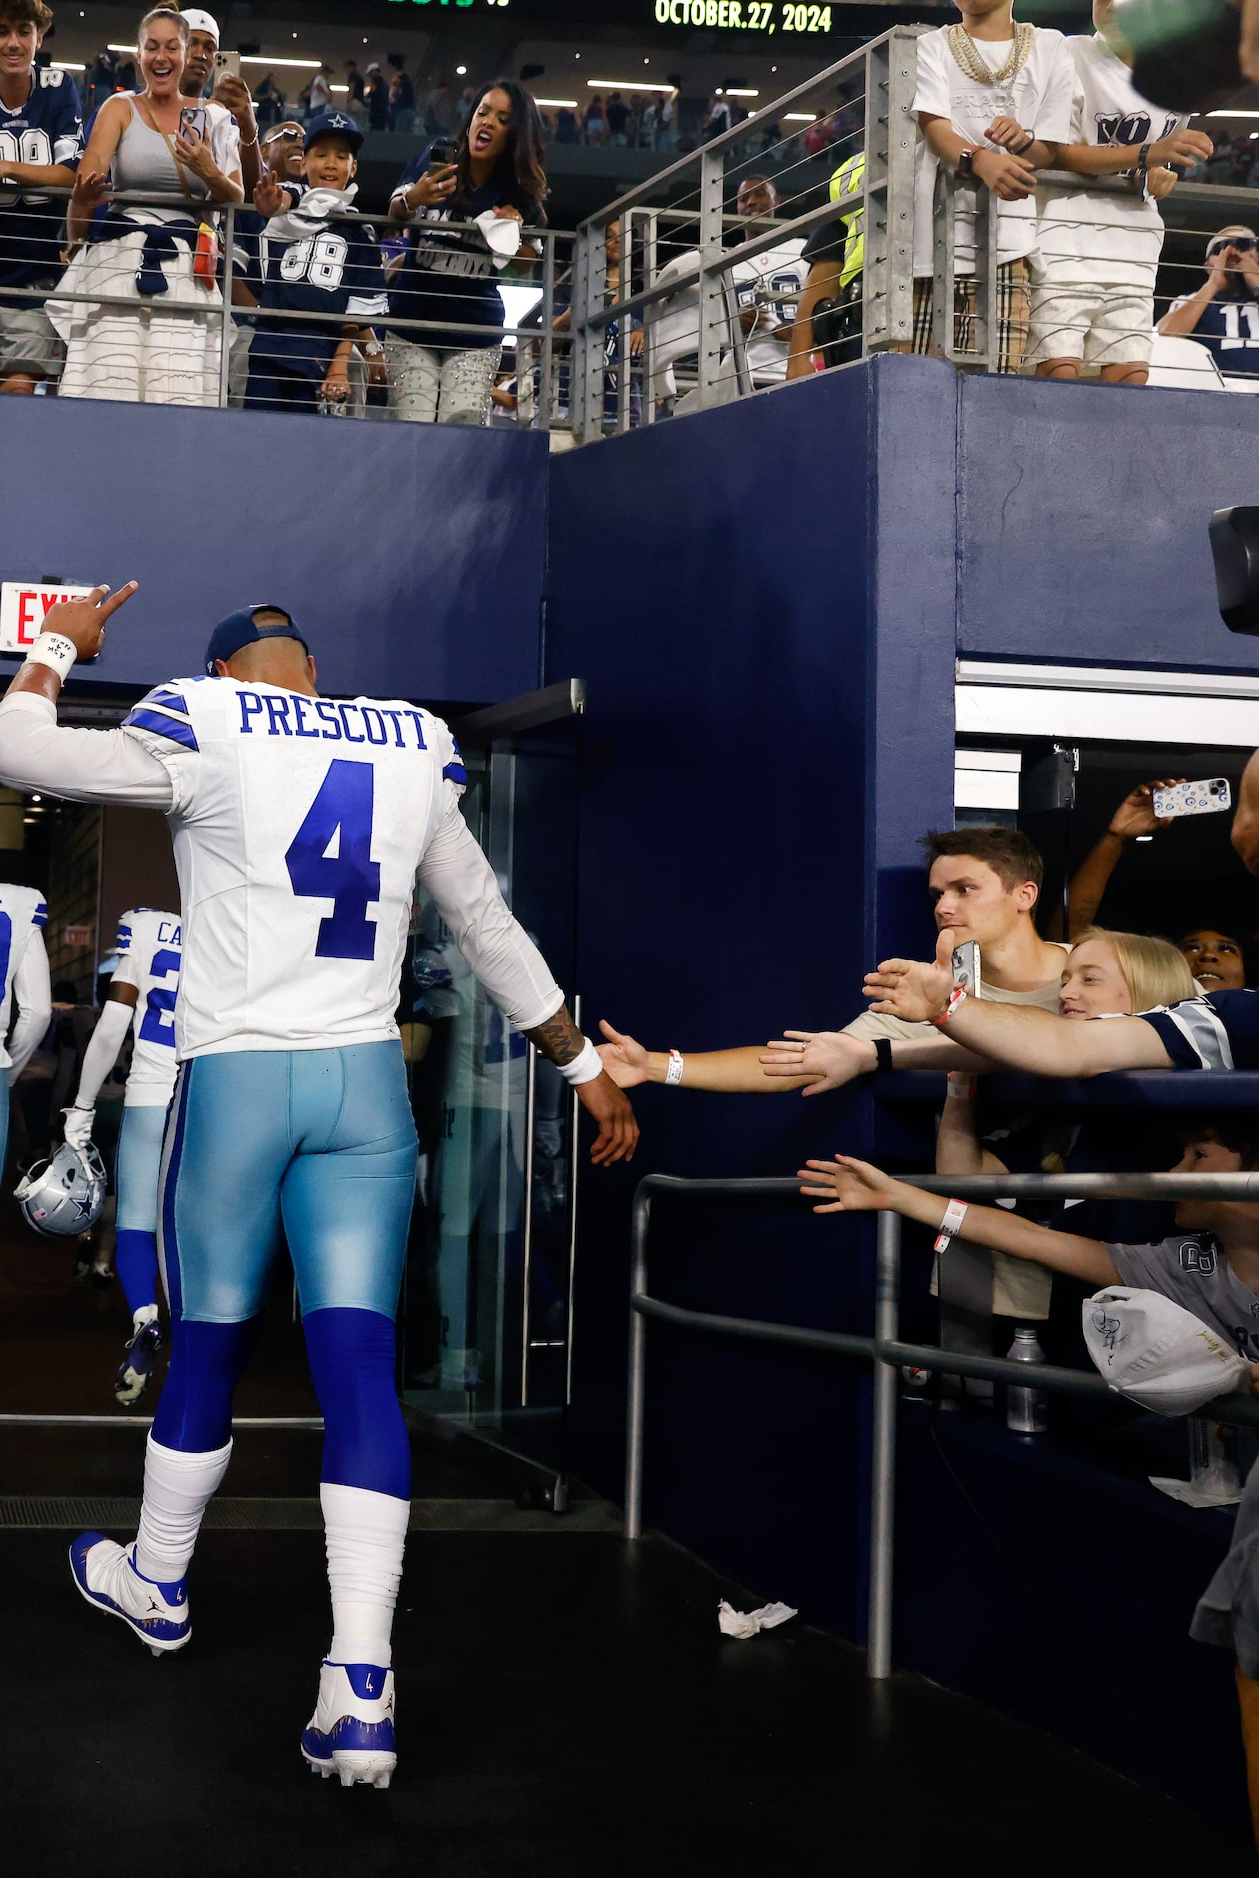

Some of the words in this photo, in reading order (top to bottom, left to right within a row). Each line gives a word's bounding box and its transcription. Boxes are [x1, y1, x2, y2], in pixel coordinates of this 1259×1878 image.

[654, 0, 776, 35] OCTOBER.27,
[782, 4, 833, 33] 2024
[951, 95, 1018, 109] PRADA
[1219, 301, 1259, 350] 11
[235, 691, 428, 751] PRESCOTT
[284, 758, 381, 961] 4
[138, 948, 182, 1049] 2
[176, 1587, 183, 1602] 4
[365, 1673, 373, 1692] 4
